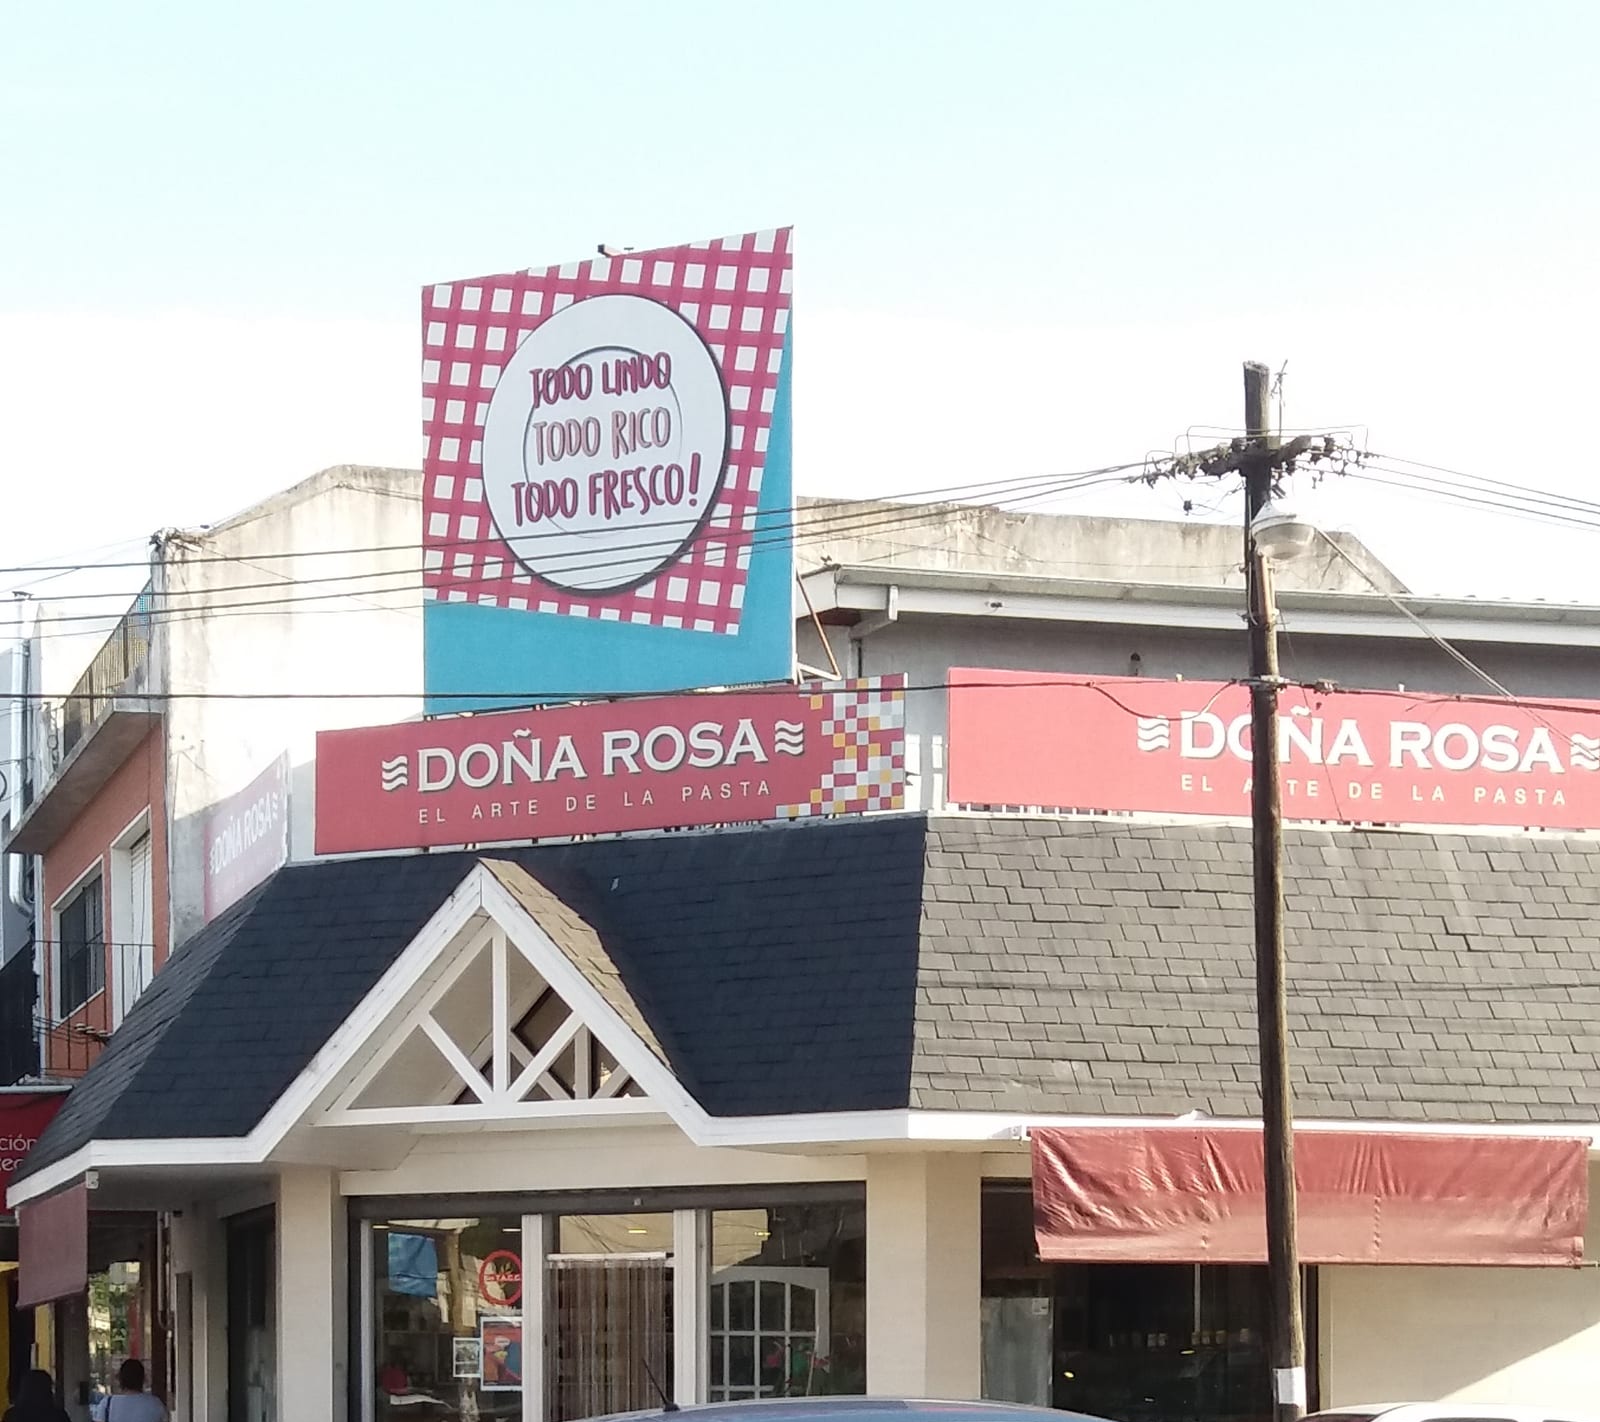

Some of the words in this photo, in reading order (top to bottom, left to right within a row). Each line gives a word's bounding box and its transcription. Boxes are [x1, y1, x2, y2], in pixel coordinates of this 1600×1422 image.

[529, 364, 593, 409] TODO
[602, 352, 671, 395] LINDO
[533, 416, 601, 465] TODO
[611, 407, 671, 459] RICO
[510, 477, 579, 526] TODO
[589, 452, 701, 520] FRESCO!
[418, 728, 587, 792] DOÑA
[603, 718, 768, 776] ROSA
[1389, 722, 1565, 773] ROSA
[419, 808, 445, 826] EL
[472, 800, 538, 820] ARTE
[566, 794, 596, 811] DE
[623, 789, 654, 807] LA
[682, 780, 771, 803] PASTA
[1181, 774, 1213, 792] EL
[1242, 777, 1319, 797] ATE
[1349, 782, 1384, 800] DE
[1412, 785, 1446, 801] LA
[1474, 786, 1567, 806] PASTA
[244, 791, 272, 849] ROSA
